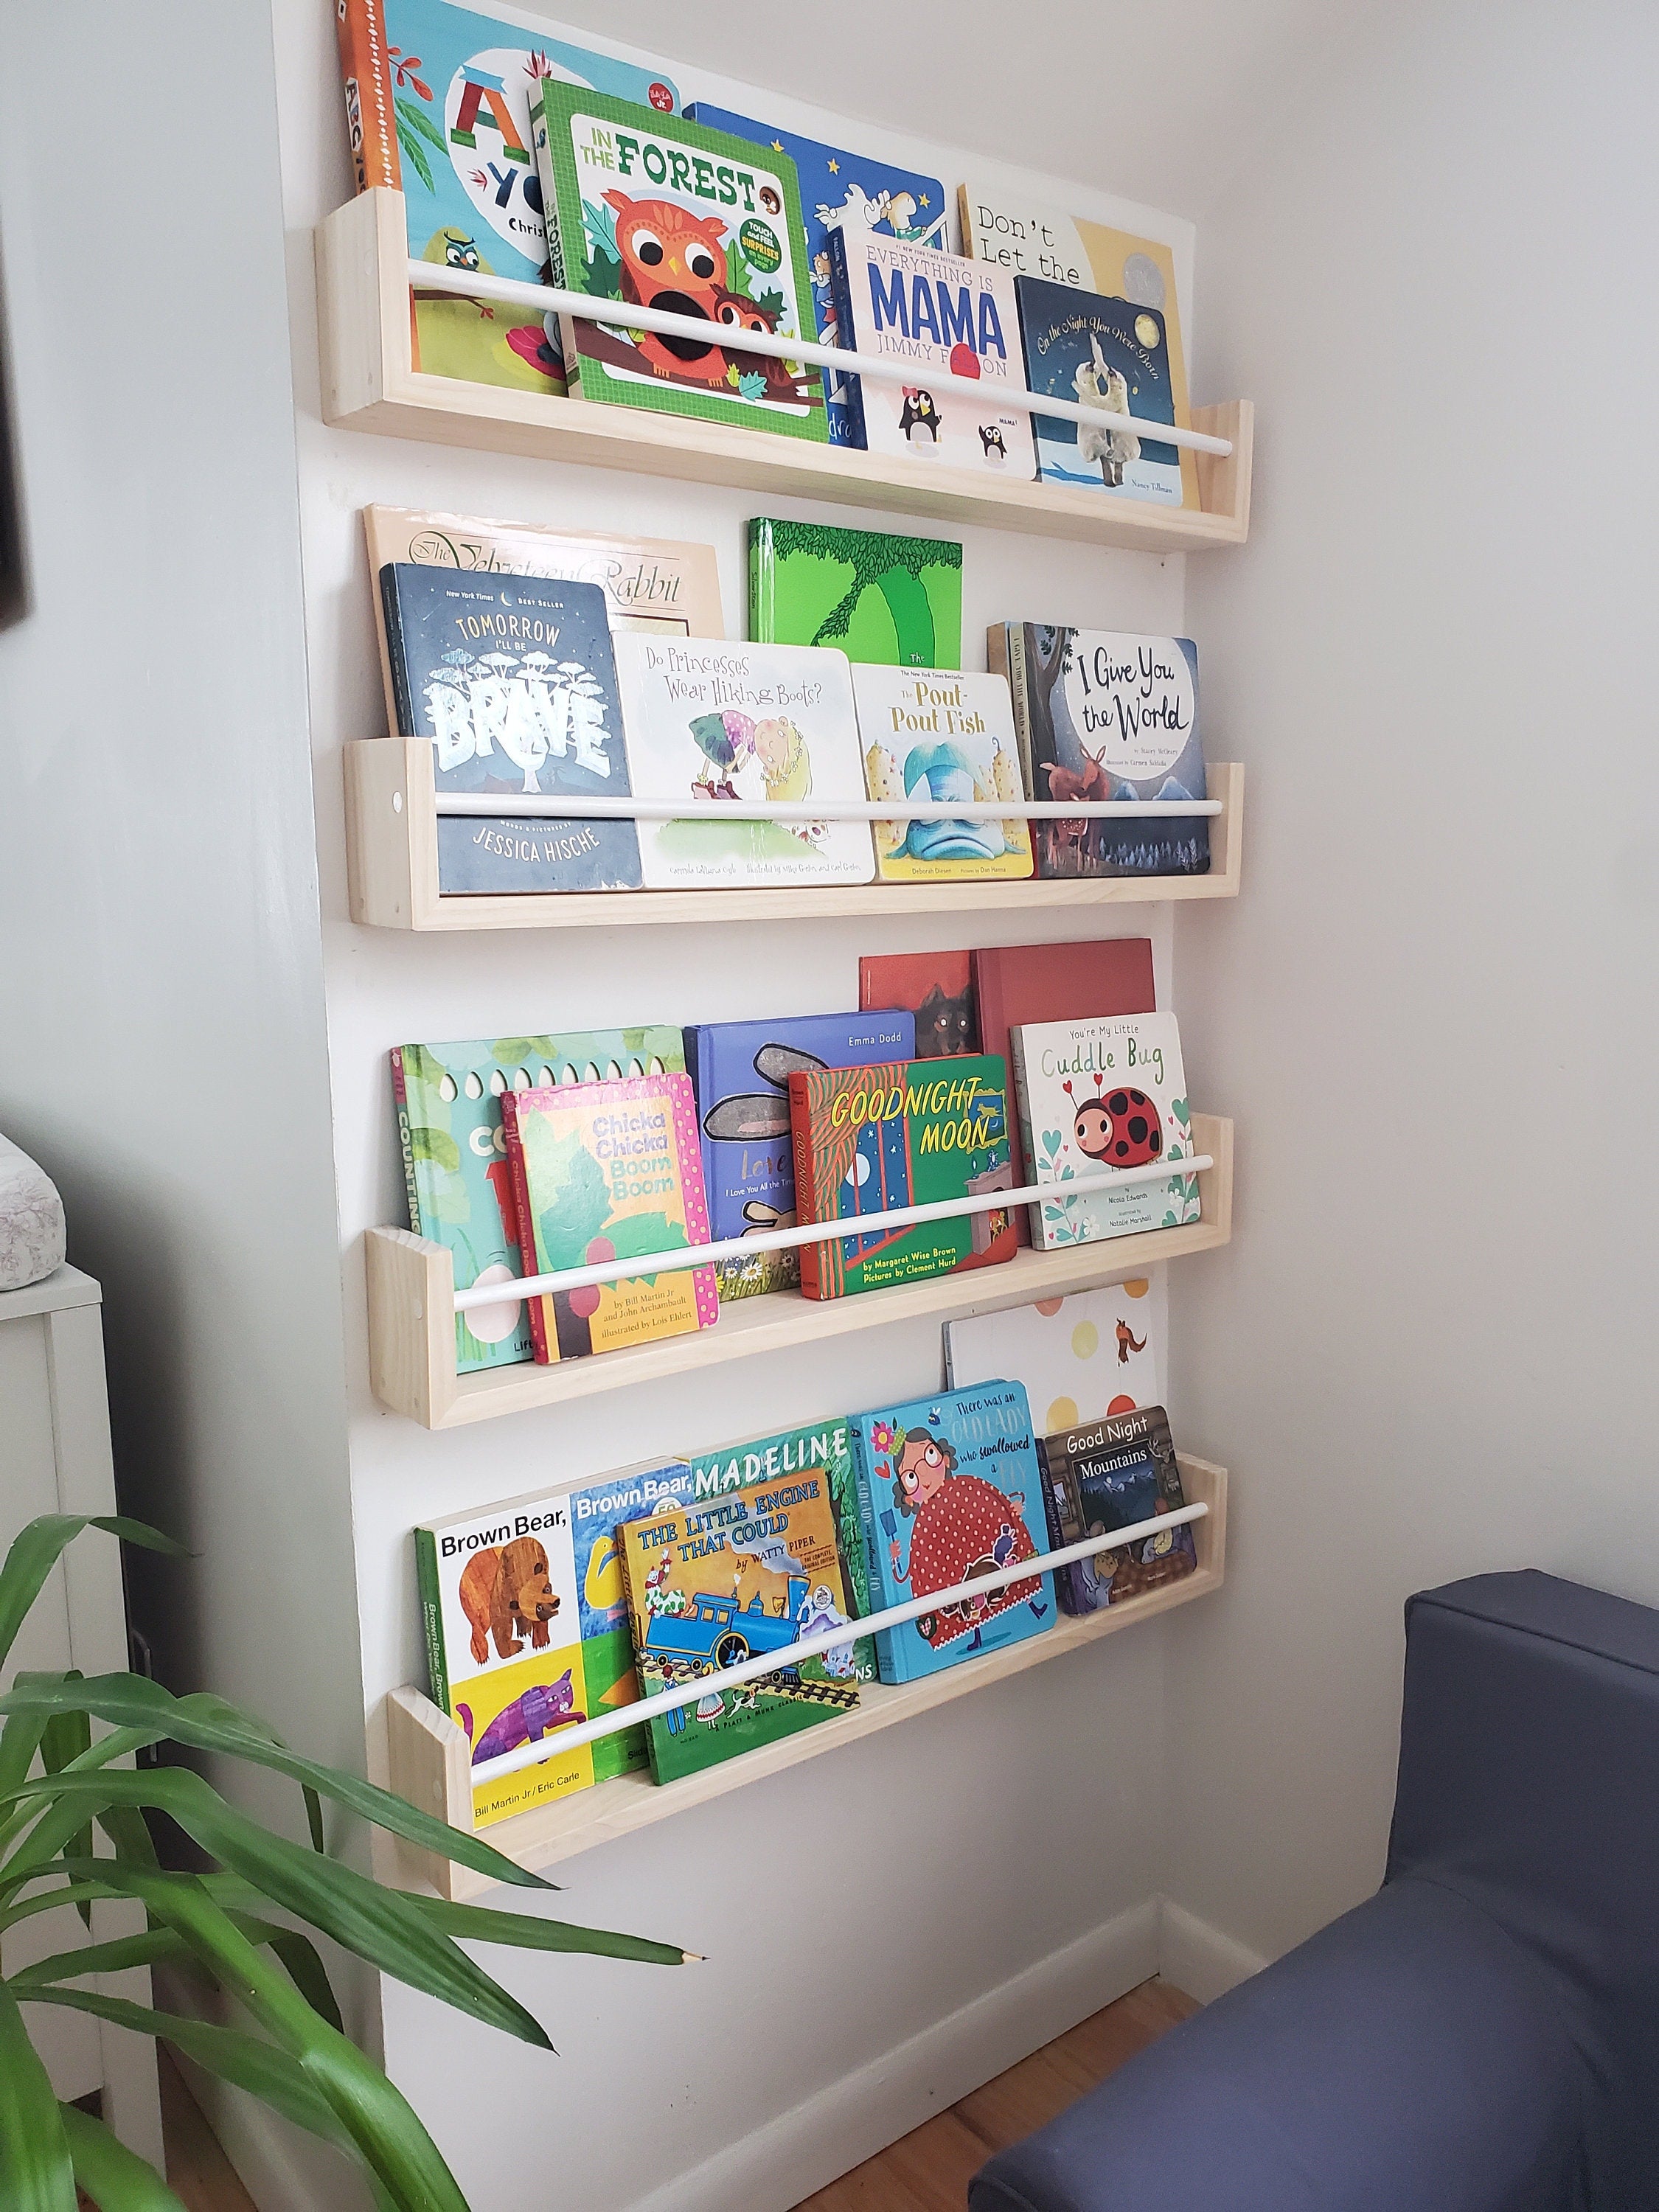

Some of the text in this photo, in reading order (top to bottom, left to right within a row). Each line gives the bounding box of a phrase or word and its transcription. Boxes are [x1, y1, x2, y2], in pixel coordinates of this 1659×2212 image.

[591, 127, 612, 149] IN
[580, 145, 615, 171] THE
[615, 133, 756, 212] FOREST
[747, 231, 775, 248] and FEEL
[748, 221, 773, 239] TOUCH
[977, 206, 1054, 247] Don't
[547, 214, 566, 290] FOREST
[742, 236, 779, 261] SURPRISES
[940, 255, 965, 267] BESTSELLER
[980, 238, 1079, 285] Let the
[866, 246, 993, 291] EVERYTHING IS
[867, 262, 1007, 360] MAMA
[877, 334, 932, 360] JIMMY
[1037, 313, 1160, 380] On the Night You Were Born
[1132, 479, 1172, 494] Nancy Tillman
[414, 540, 681, 606] The Rabbit
[446, 589, 495, 602] New York Times
[455, 613, 560, 647] TOMORROW
[495, 639, 526, 652] I'LL BE
[646, 647, 749, 678] Do Princesses
[910, 652, 925, 664] The
[1077, 646, 1175, 698] I Give You
[664, 675, 822, 707] Wear Hiking Boots?
[912, 681, 967, 708] Pout-
[431, 678, 611, 779] BRAVE
[888, 706, 987, 735] Pout Fish
[1082, 694, 1189, 741] the World
[473, 827, 600, 863] JESSICA HISCHE
[849, 1032, 901, 1046] Emma Dodd
[1069, 1025, 1139, 1040] You're My Little
[1041, 1041, 1116, 1078] Cuddle
[1127, 1037, 1164, 1085] Bug
[831, 1077, 983, 1127] GOODNIGHT
[593, 1111, 666, 1137] Chicka
[920, 1116, 990, 1155] MOON
[596, 1133, 668, 1159] Chicka
[398, 1110, 422, 1237] COUNTING
[611, 1156, 672, 1179] Boom
[796, 1130, 810, 1210] GOODNIGHT
[512, 1161, 527, 1247] Chicka Chicka
[613, 1178, 675, 1200] Boom
[730, 1189, 745, 1197] Love
[746, 1186, 759, 1194] You
[769, 1180, 780, 1189] the
[1126, 1193, 1148, 1202] Edwards
[1109, 1214, 1152, 1227] Natalie Marshall
[863, 1247, 956, 1271] by Margaret Wise Brown
[863, 1256, 956, 1283] Pictures by Clement Hurd
[604, 1296, 686, 1322] and John Archambault
[614, 1289, 674, 1310] by Bill Martin Jr
[602, 1312, 692, 1338] illustrated by Lois Ehlert
[956, 1393, 1015, 1416] There was an
[960, 1434, 1030, 1463] who swallowed
[1067, 1416, 1148, 1453] Good Night
[695, 1427, 847, 1497] MADELINE
[991, 1464, 998, 1473] a
[1079, 1447, 1147, 1480] Mountains
[577, 1474, 692, 1520] Brown Bear,
[1040, 1467, 1058, 1526] Good Night
[638, 1480, 820, 1550] THE LITTLE ENGINE
[441, 1509, 567, 1557] Brown Bear,
[678, 1513, 789, 1562] THAT COULD
[736, 1535, 815, 1573] by WATTY PIPER
[867, 1537, 877, 1570] swallowed
[428, 1604, 445, 1710] Brown Bear, Brown
[475, 1772, 580, 1818] Bill Martin Jr Eric Carle
